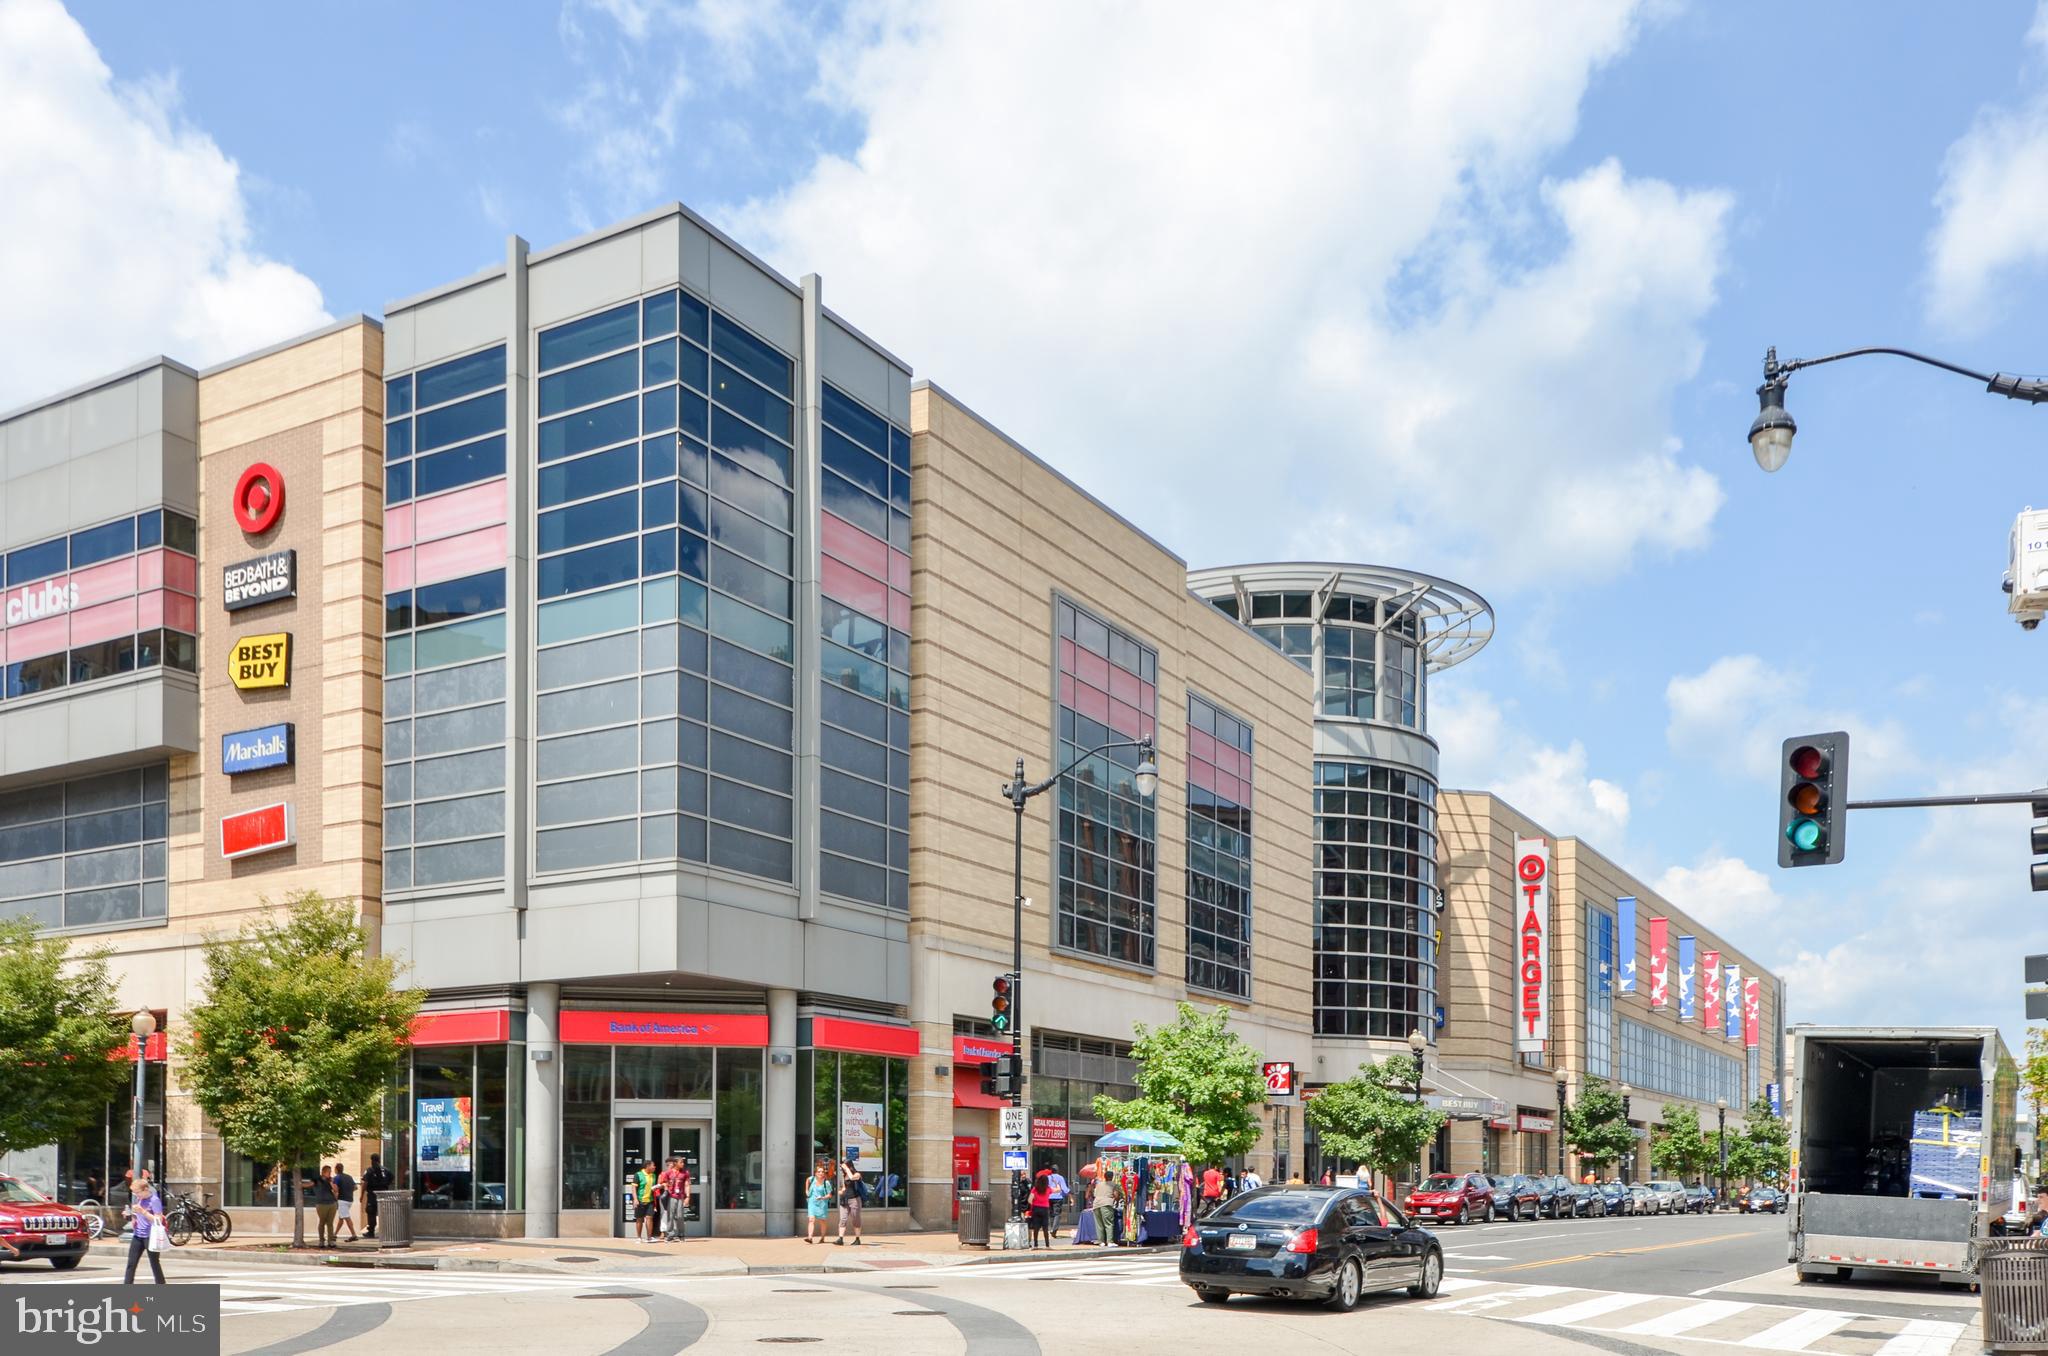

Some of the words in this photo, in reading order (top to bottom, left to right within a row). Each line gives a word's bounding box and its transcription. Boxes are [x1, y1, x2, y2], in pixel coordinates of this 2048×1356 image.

[225, 568, 246, 589] BED
[247, 559, 277, 583] BATH
[277, 557, 288, 575] &
[225, 576, 288, 603] BEYOND
[7, 580, 79, 625] clubs
[238, 642, 283, 662] BEST
[239, 661, 278, 681] BUY
[225, 735, 286, 763] Marshalls
[1521, 885, 1542, 1036] TARGET
[609, 1022, 638, 1033] Bank
[640, 1024, 651, 1033] of
[653, 1024, 698, 1035] America
[420, 1101, 445, 1113] Travel
[845, 1104, 864, 1115] Travel
[1442, 1100, 1463, 1108] BEST
[421, 1113, 452, 1124] without
[845, 1115, 869, 1126] without
[1005, 1111, 1023, 1121] ONE
[421, 1125, 443, 1135] limits
[845, 1127, 860, 1137] rules
[1005, 1121, 1024, 1131] WAY
